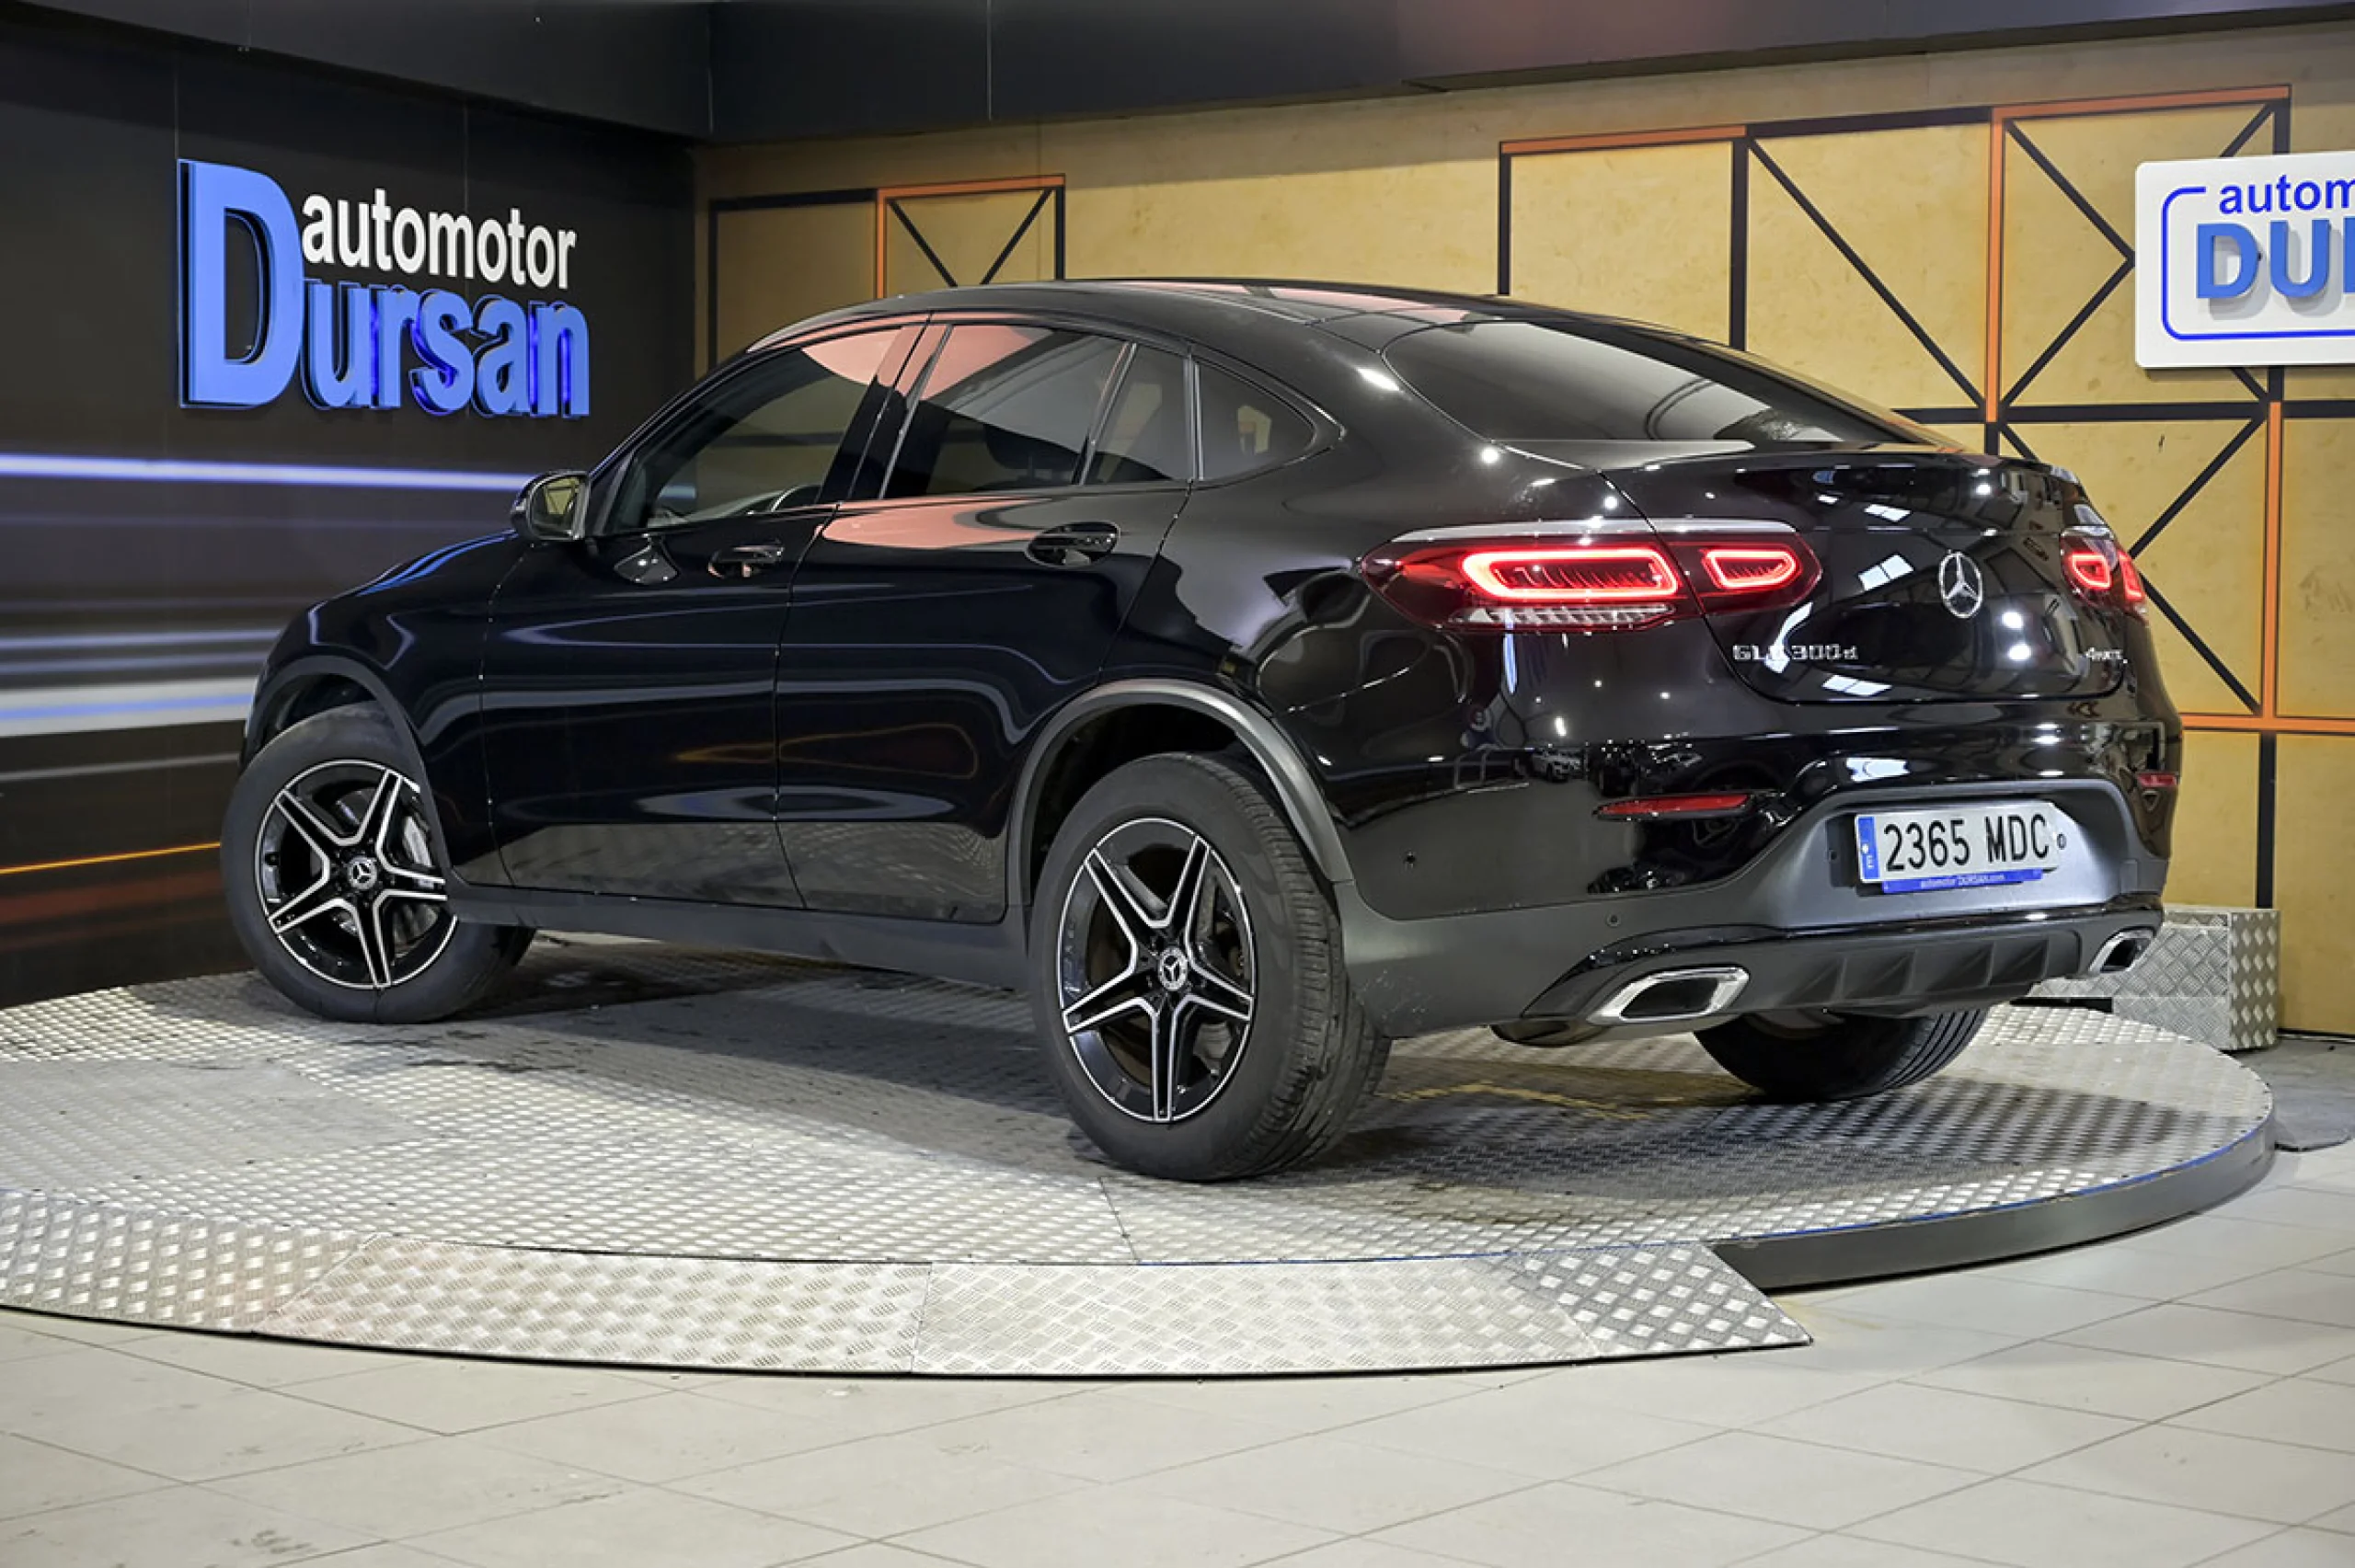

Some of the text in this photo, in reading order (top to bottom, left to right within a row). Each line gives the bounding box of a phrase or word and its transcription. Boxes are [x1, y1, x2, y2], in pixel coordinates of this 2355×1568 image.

[302, 189, 576, 289] automotor
[2196, 217, 2355, 299] DU
[178, 158, 589, 418] Dursan
[1884, 814, 2050, 871] 2365 MDC
